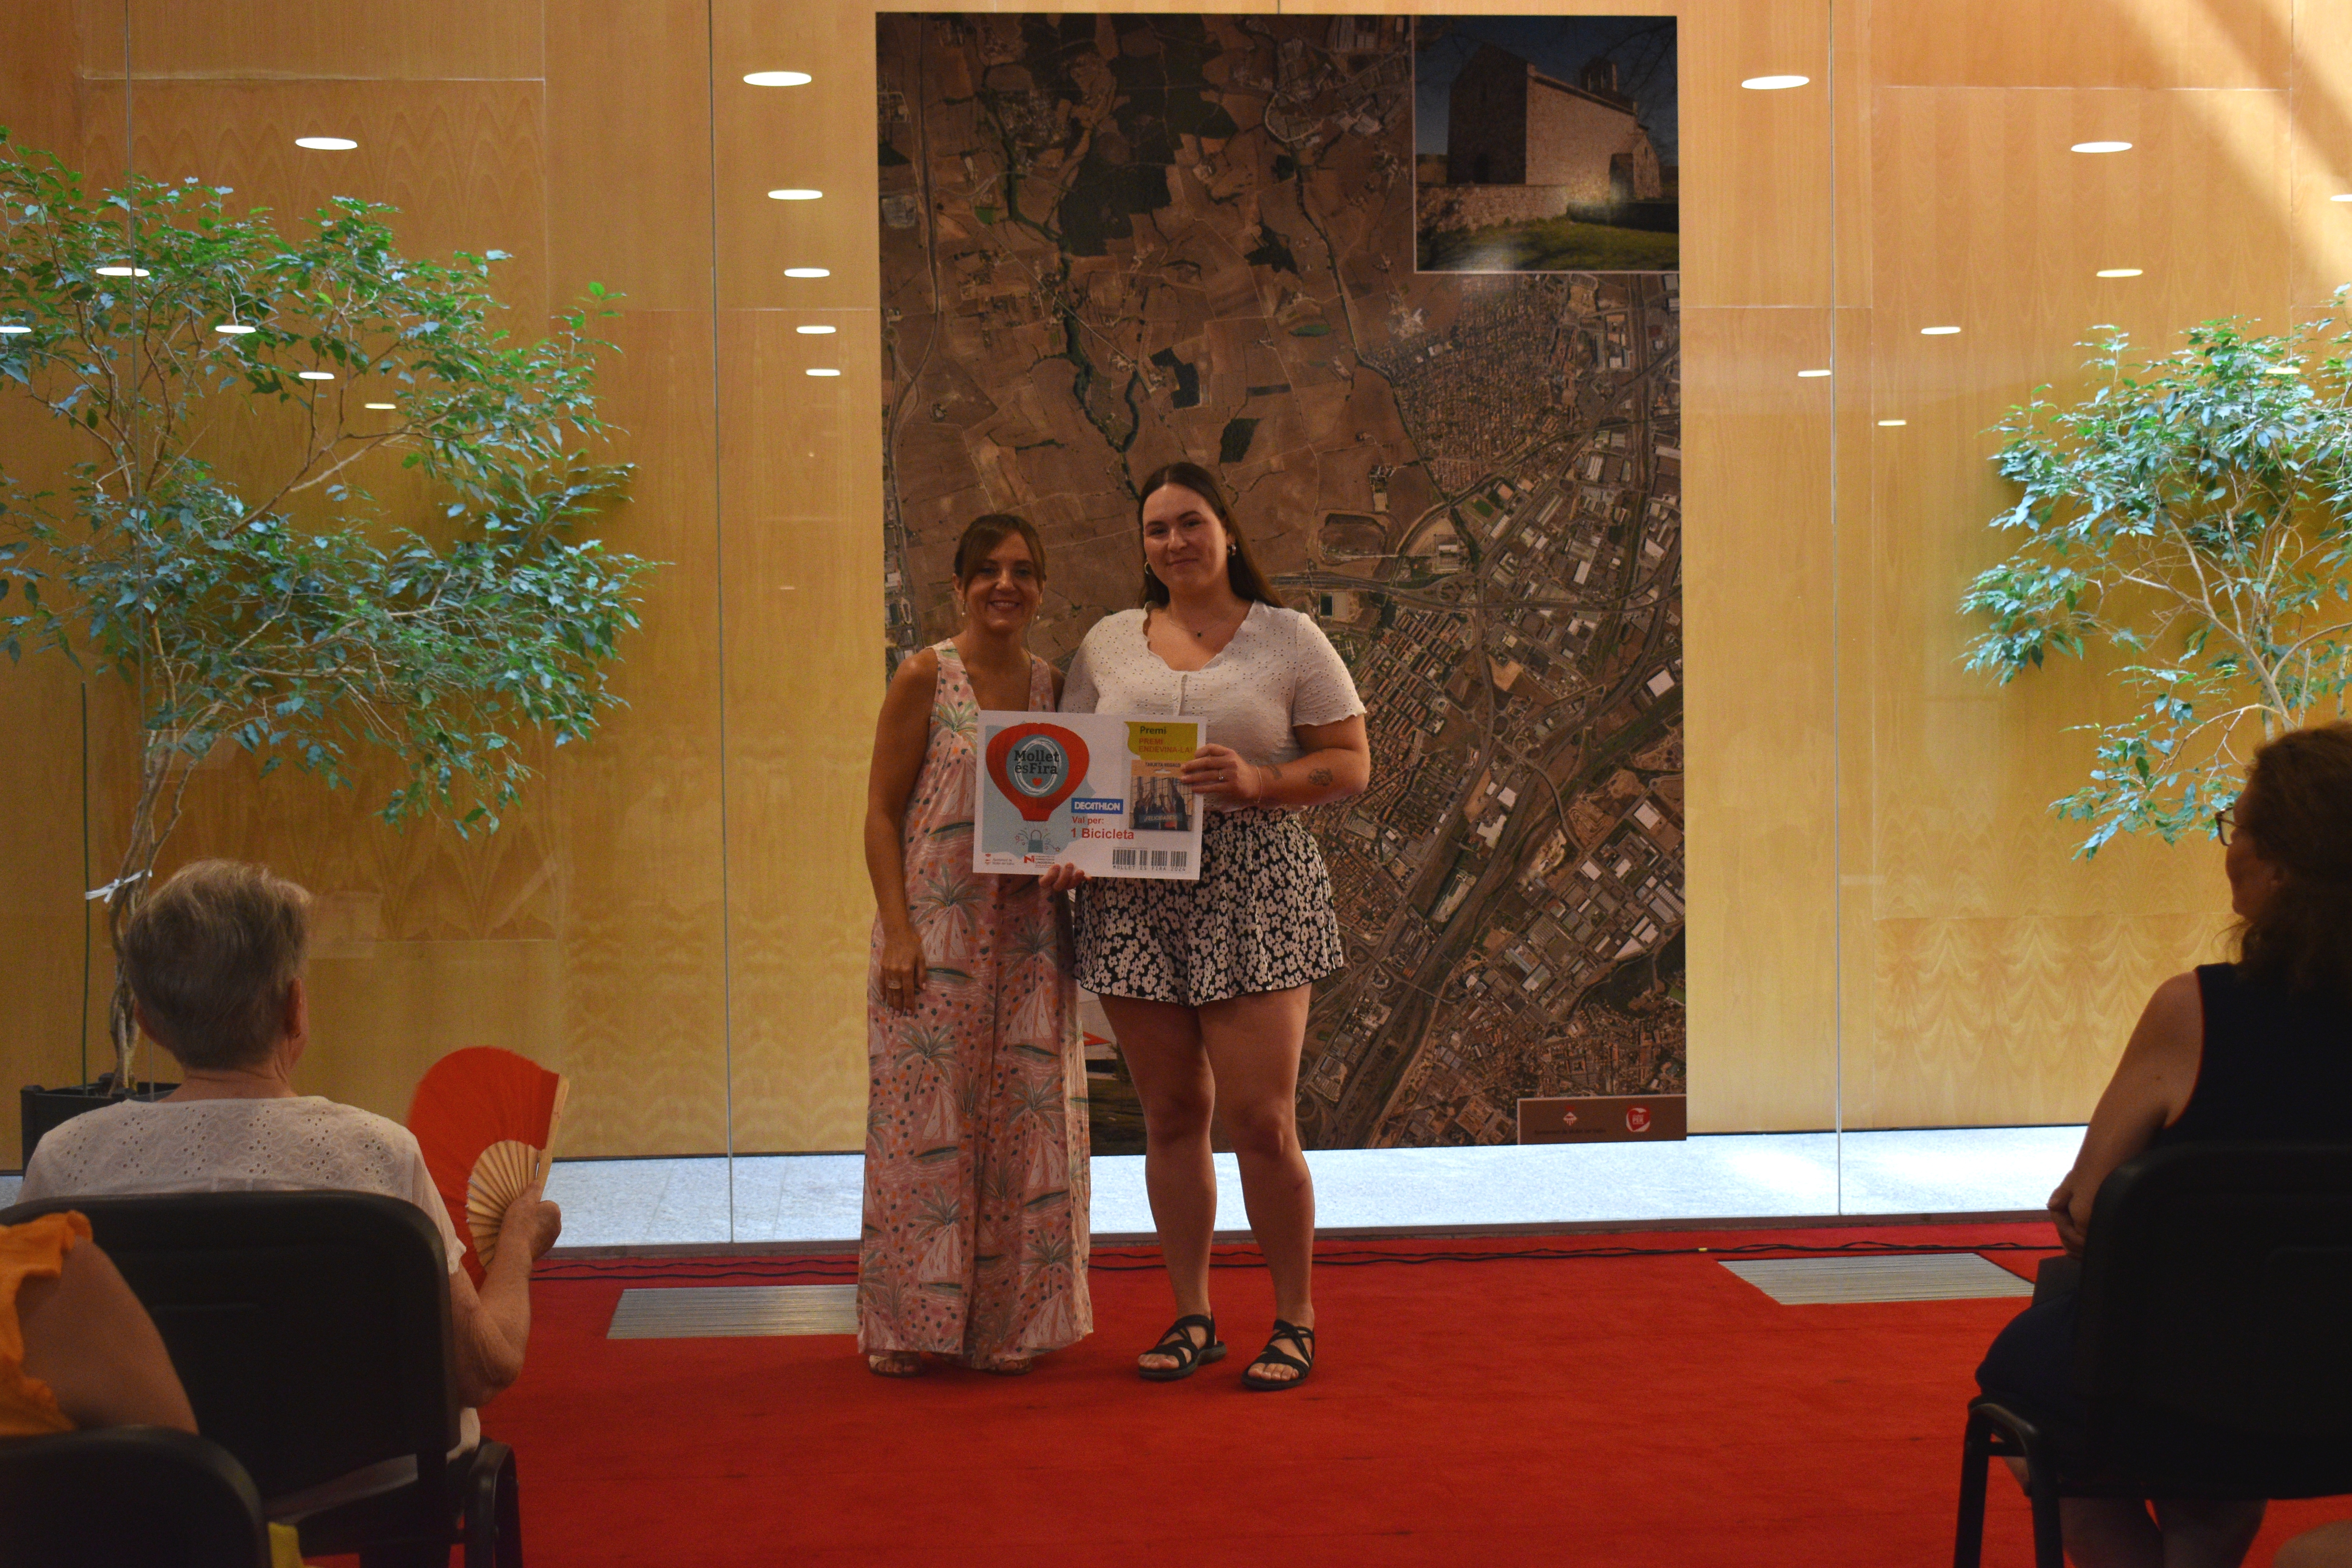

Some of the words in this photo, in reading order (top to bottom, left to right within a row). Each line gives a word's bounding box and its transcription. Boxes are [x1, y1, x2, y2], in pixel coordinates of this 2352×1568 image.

[1014, 750, 1060, 762] Mollet
[1074, 801, 1120, 811] DECATHLON
[1071, 828, 1076, 838] 1
[1082, 828, 1134, 839] Bicicleta
